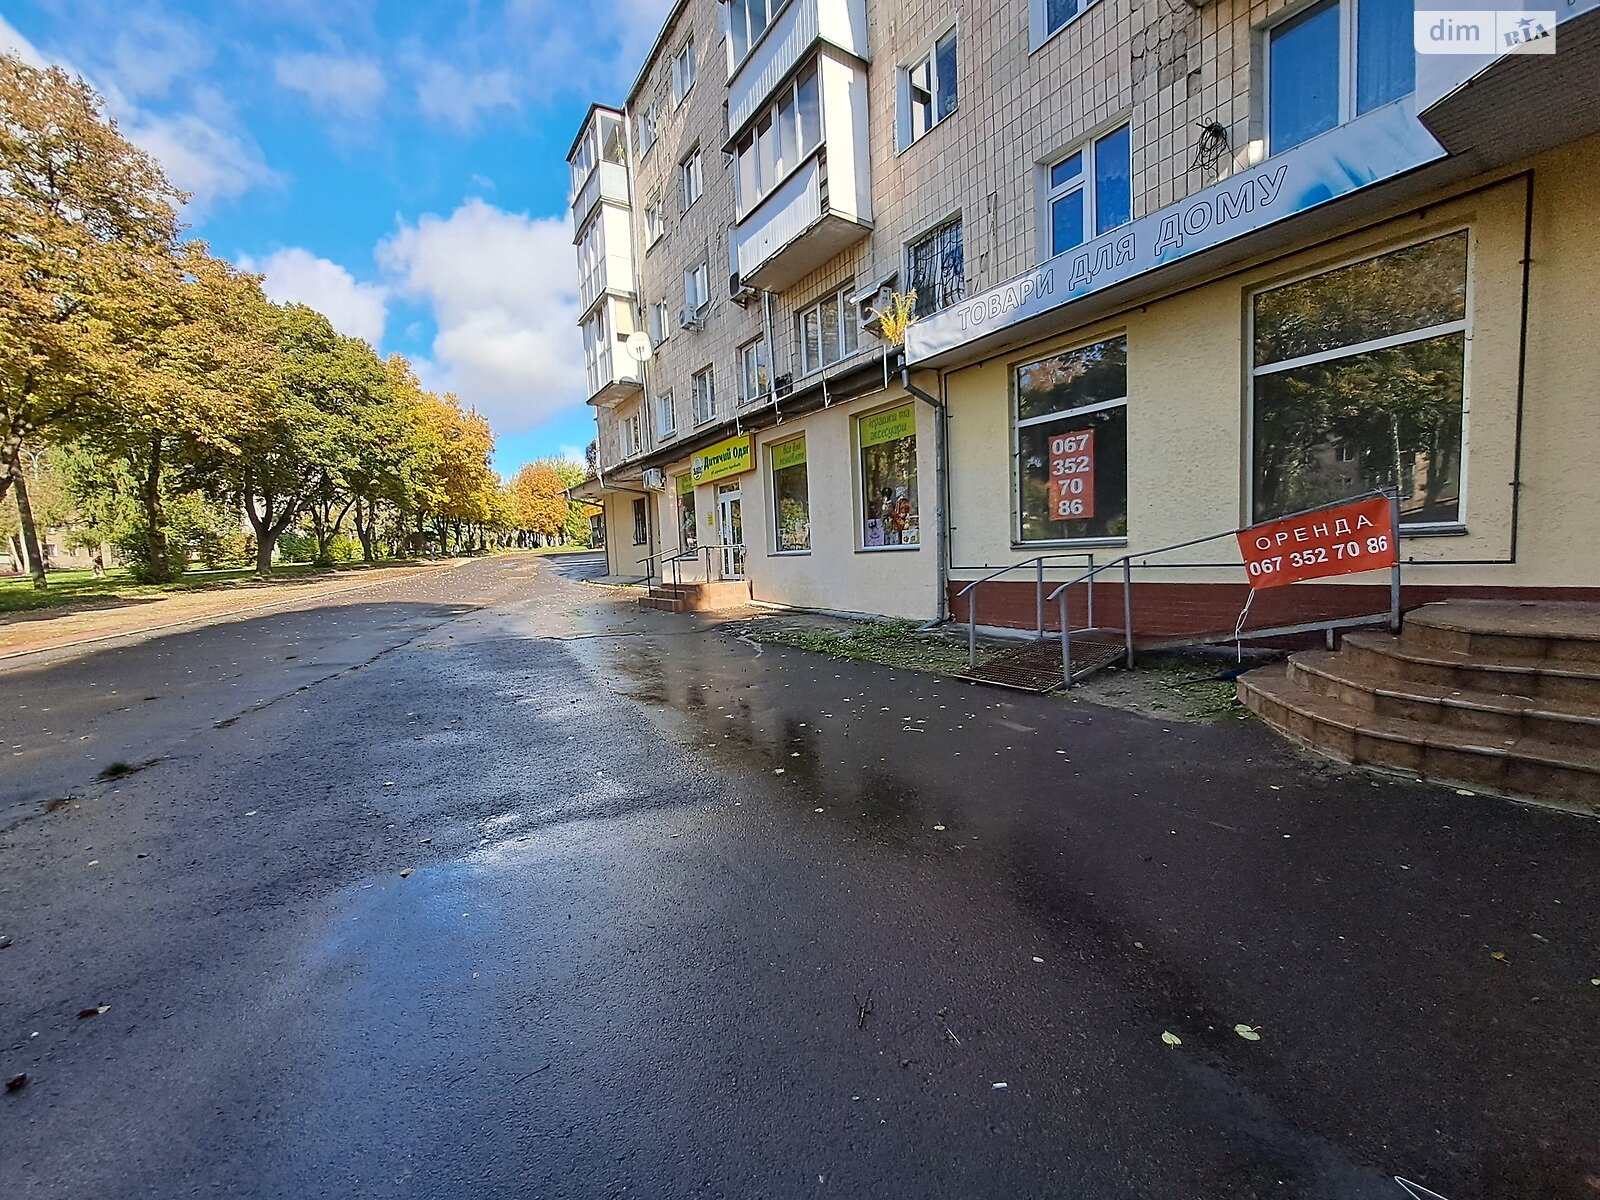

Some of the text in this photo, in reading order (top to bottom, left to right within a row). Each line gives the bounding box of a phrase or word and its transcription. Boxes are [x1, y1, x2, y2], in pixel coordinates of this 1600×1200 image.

[957, 164, 1288, 330] ТОВАРИ ДЛЯ ДОМУ
[1051, 433, 1089, 455] 067
[703, 447, 732, 471] Дитячий
[732, 445, 750, 459] Одяг
[1052, 455, 1090, 476] 352
[1058, 477, 1083, 496] 70
[1058, 498, 1083, 516] 86
[1255, 514, 1374, 550] ОРЕНДА
[1249, 535, 1389, 577] 067 352 70 86
